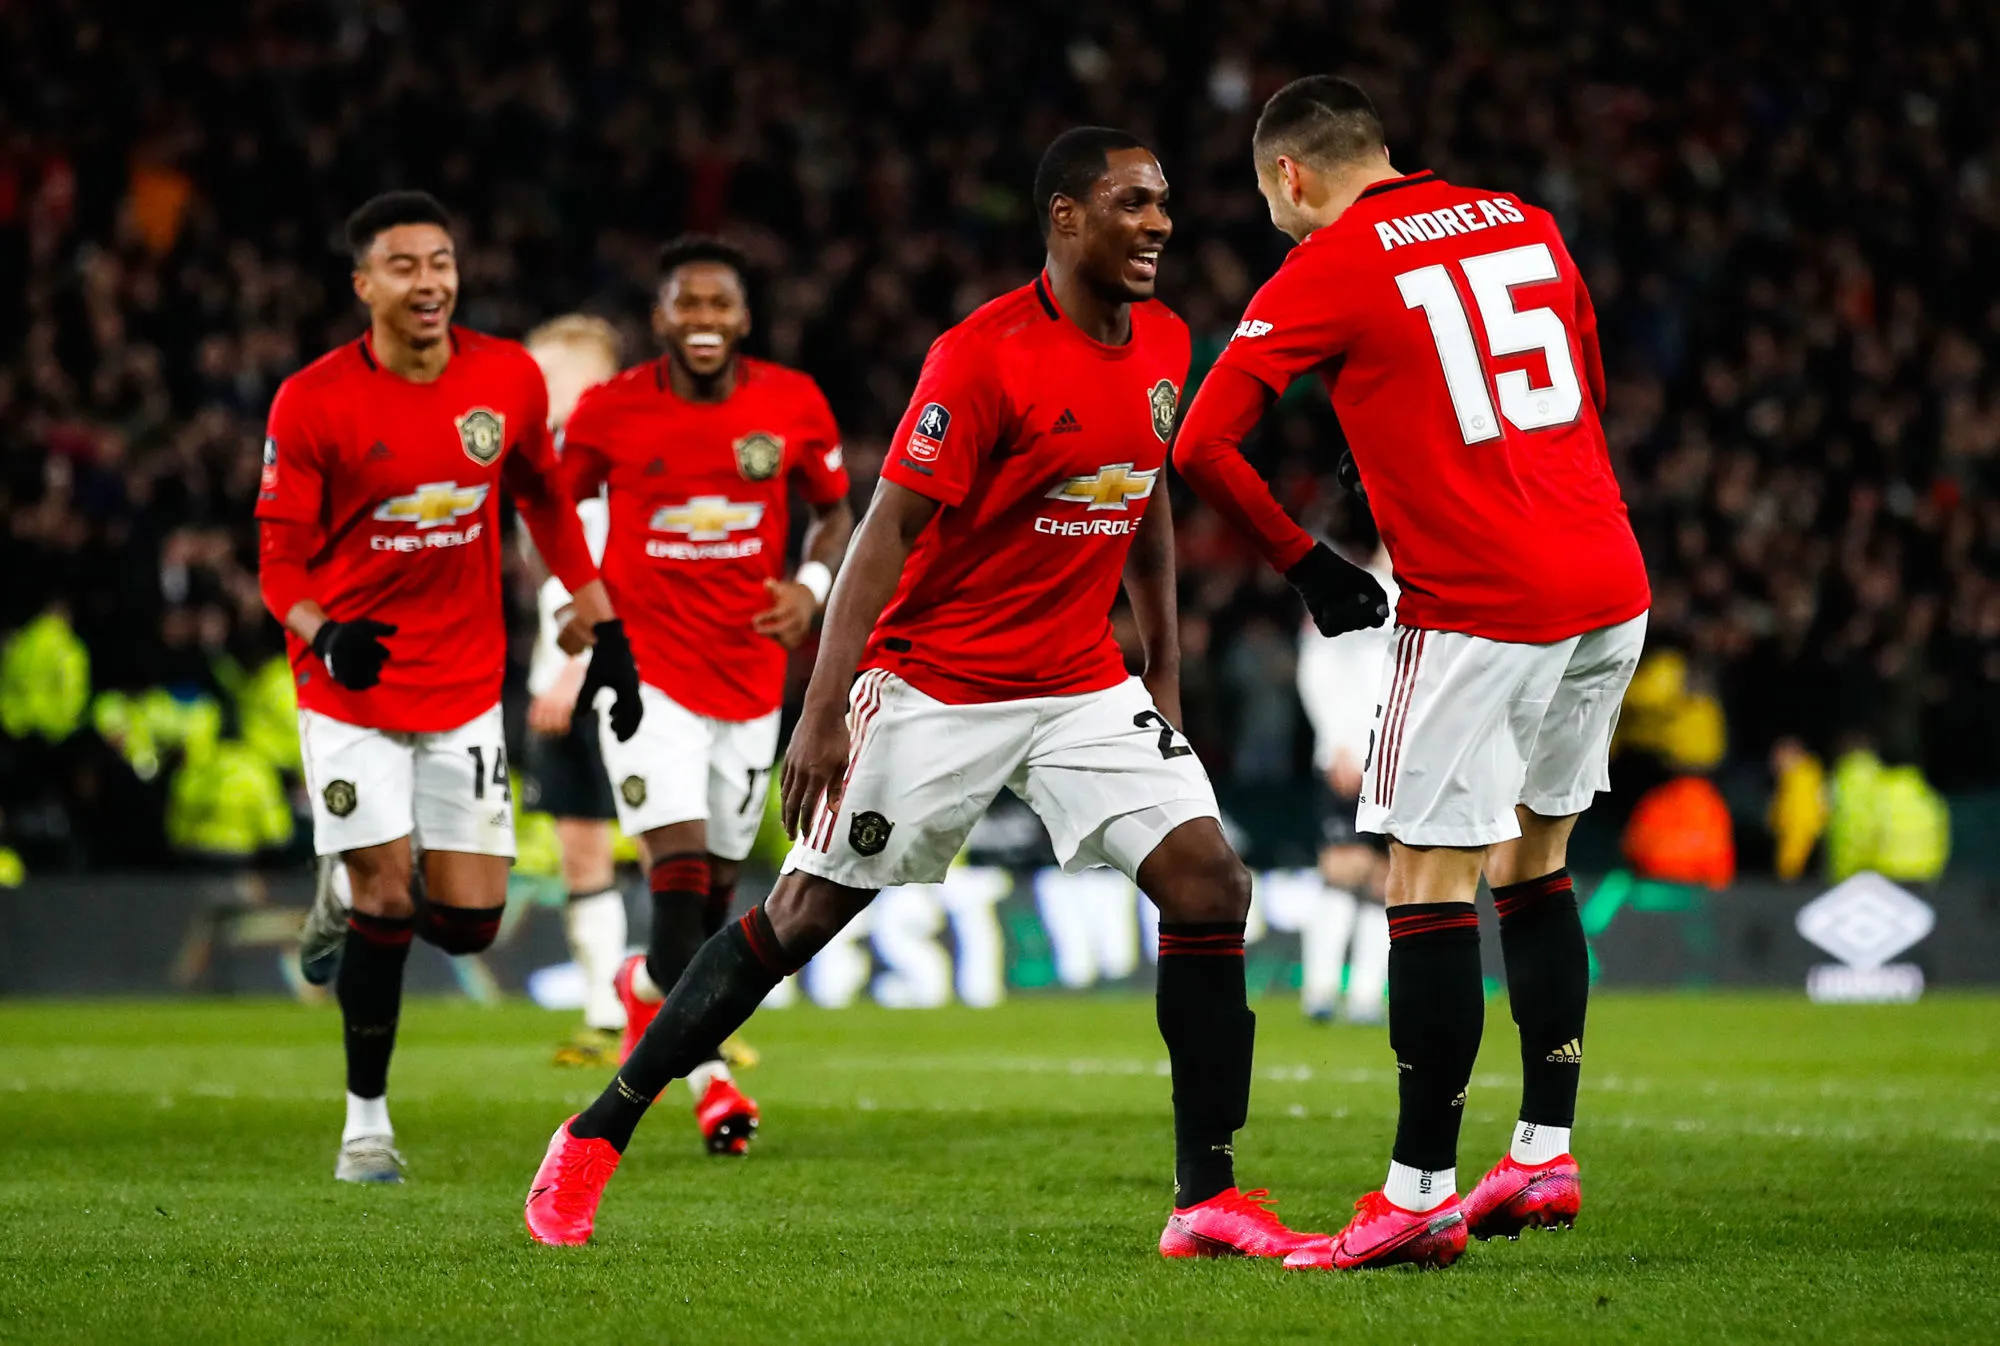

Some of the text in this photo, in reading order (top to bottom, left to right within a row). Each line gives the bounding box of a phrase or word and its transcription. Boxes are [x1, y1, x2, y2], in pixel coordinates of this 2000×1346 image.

[1374, 198, 1525, 251] ANDREAS
[1394, 243, 1583, 446] 15
[1034, 517, 1143, 536] CHEVROLE
